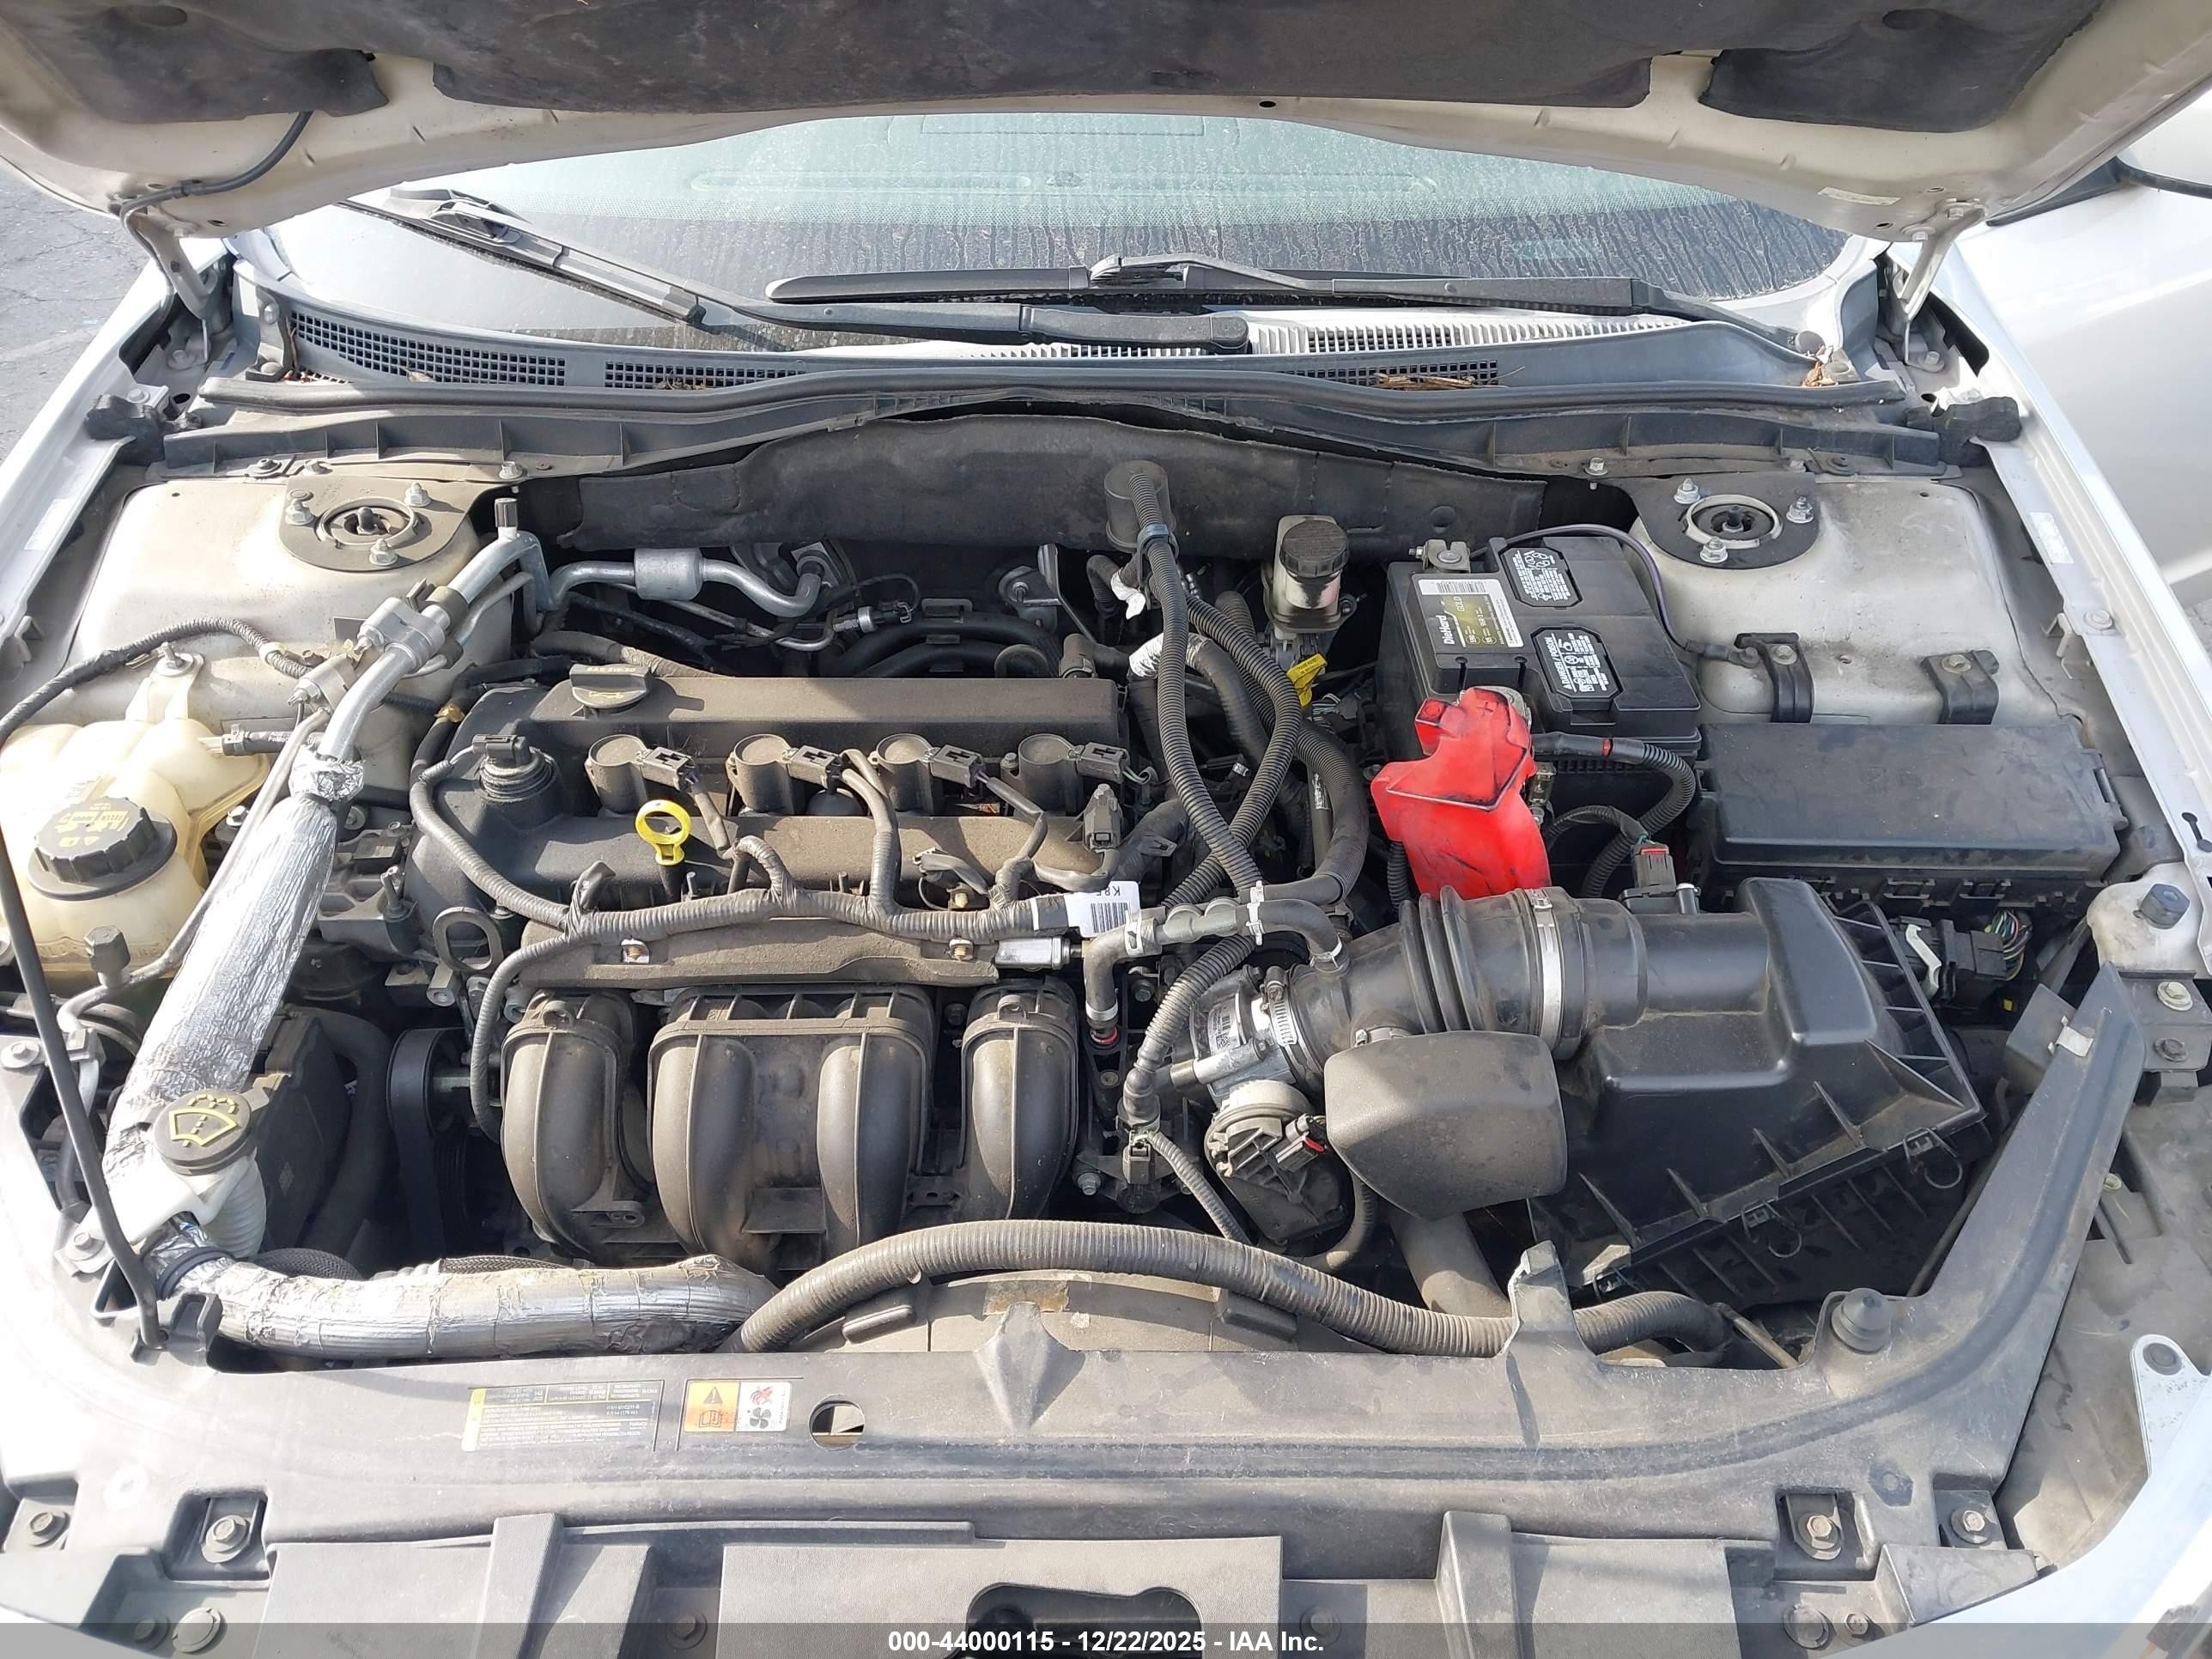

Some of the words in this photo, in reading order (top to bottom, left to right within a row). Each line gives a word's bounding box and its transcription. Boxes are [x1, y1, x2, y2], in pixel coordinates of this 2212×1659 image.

[1453, 596, 1465, 612] GOLD
[1436, 615, 1455, 645] DieHard
[1544, 637, 1558, 657] POISON
